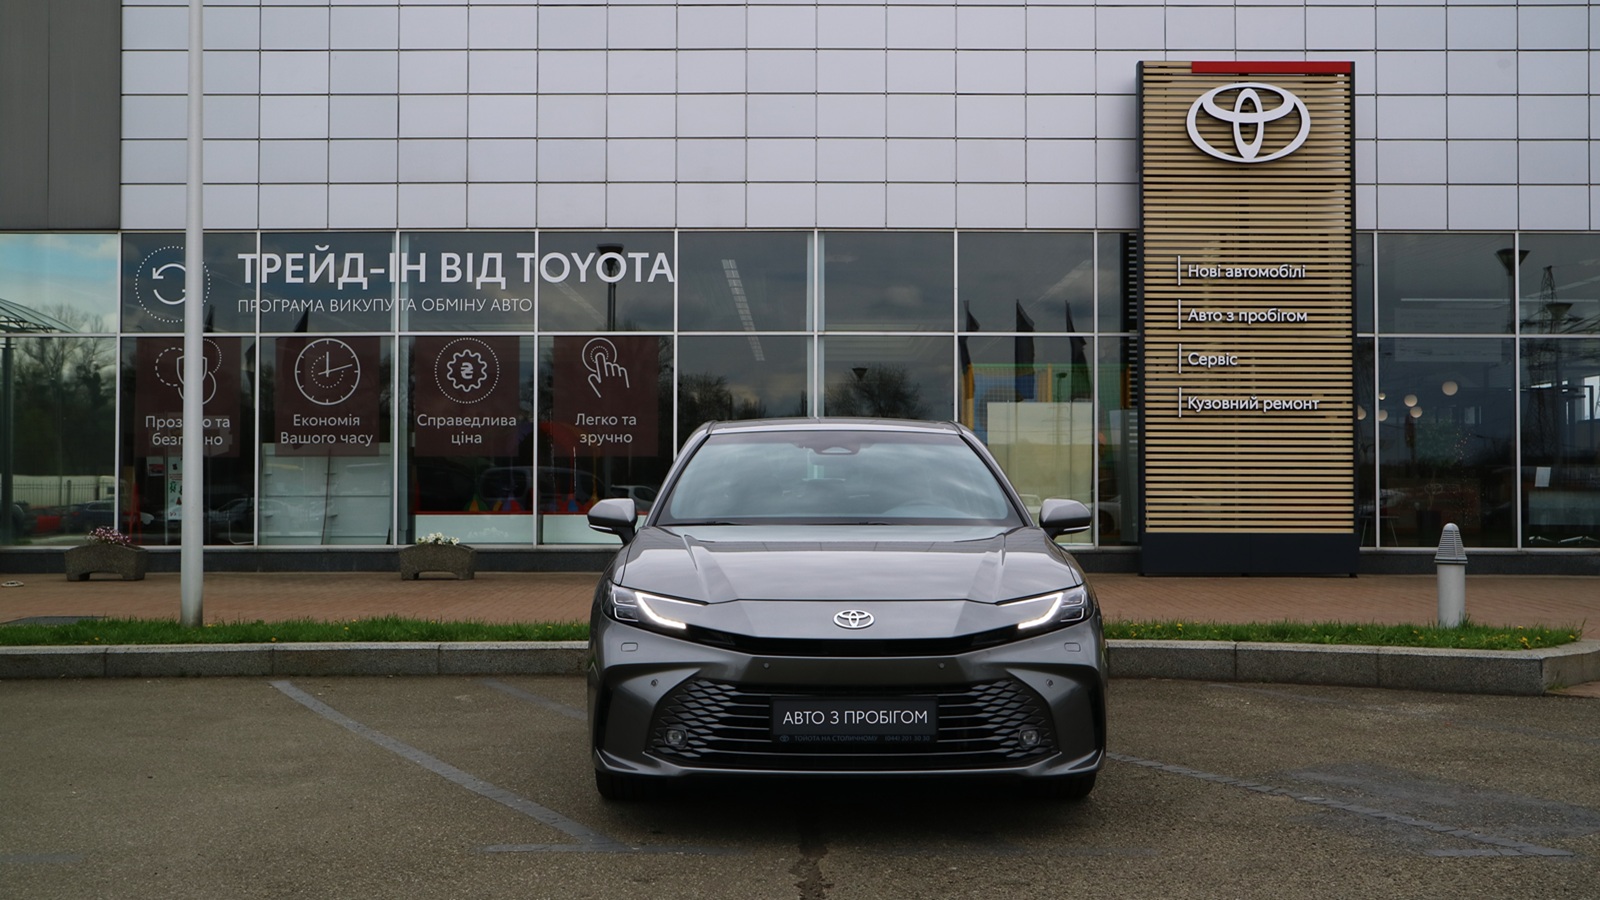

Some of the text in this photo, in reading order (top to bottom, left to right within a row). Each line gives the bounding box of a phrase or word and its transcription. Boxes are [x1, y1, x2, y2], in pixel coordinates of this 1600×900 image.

[238, 244, 675, 289] ТРЕЙД-ІН ВІД TOYOTA
[1187, 264, 1306, 279] Нові автомобілі
[238, 298, 532, 312] ПРОГРАМА ВИКУПУ ТА ОБМІНУ АВТО
[1188, 308, 1308, 325] Авто з пробігом
[1187, 353, 1238, 369] Сервіс
[1187, 396, 1320, 413] Кузовний ремонт
[145, 415, 231, 430] Прозо та
[293, 413, 360, 427] Економія
[417, 413, 517, 429] Справедлива
[575, 413, 637, 426] Легко та
[280, 431, 374, 448] Вашого часу
[451, 431, 482, 446] ціна
[580, 433, 633, 448] зручно
[782, 709, 929, 725] АВТО З ПРОБІГОМ
